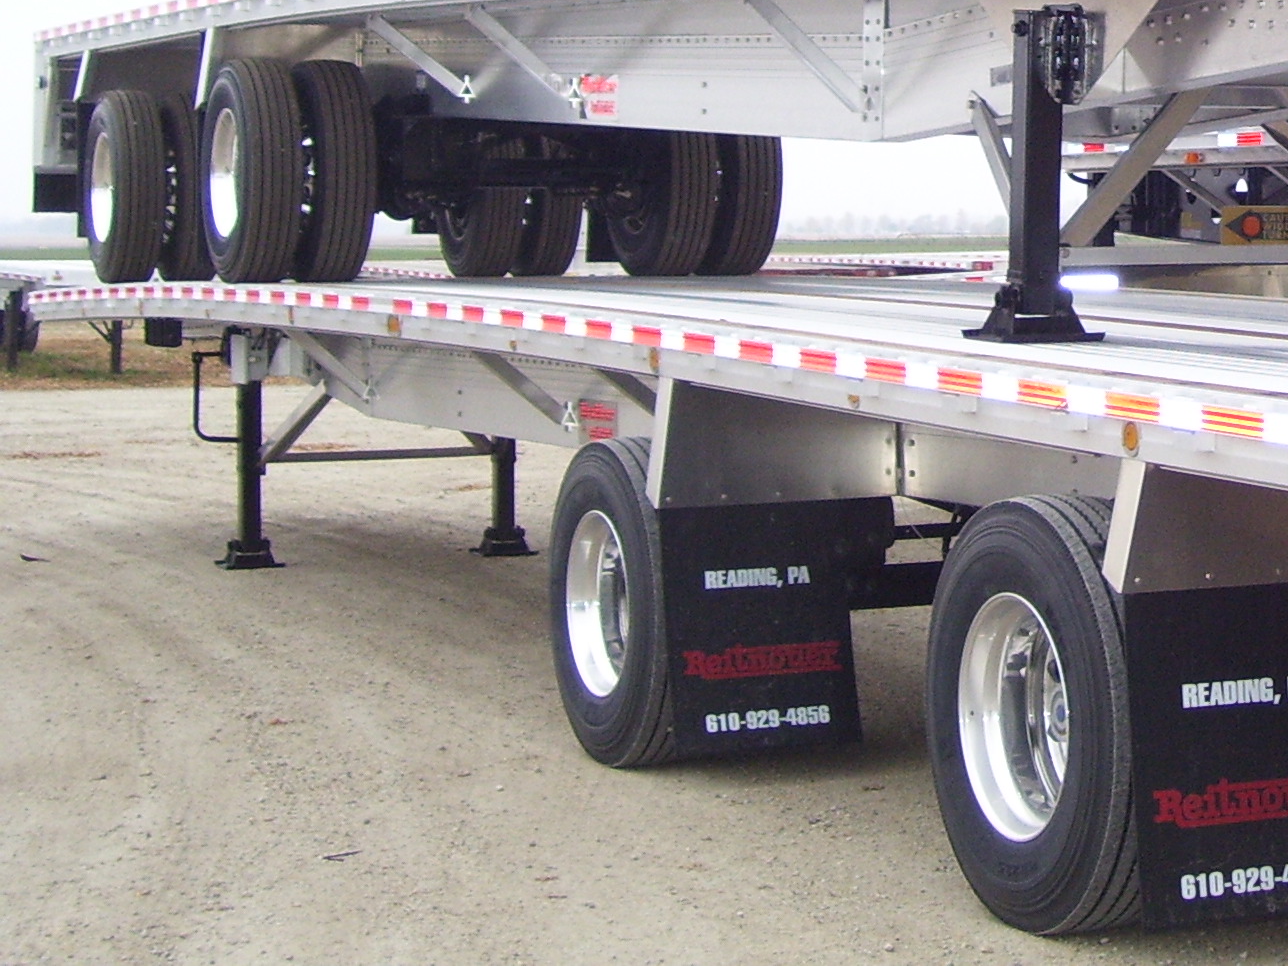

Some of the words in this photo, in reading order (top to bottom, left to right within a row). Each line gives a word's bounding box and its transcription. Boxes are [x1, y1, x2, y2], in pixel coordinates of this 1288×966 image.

[704, 567, 783, 589] READING,
[787, 565, 811, 584] PA
[1181, 677, 1281, 709] READING,
[705, 705, 831, 733] 610-929-4856
